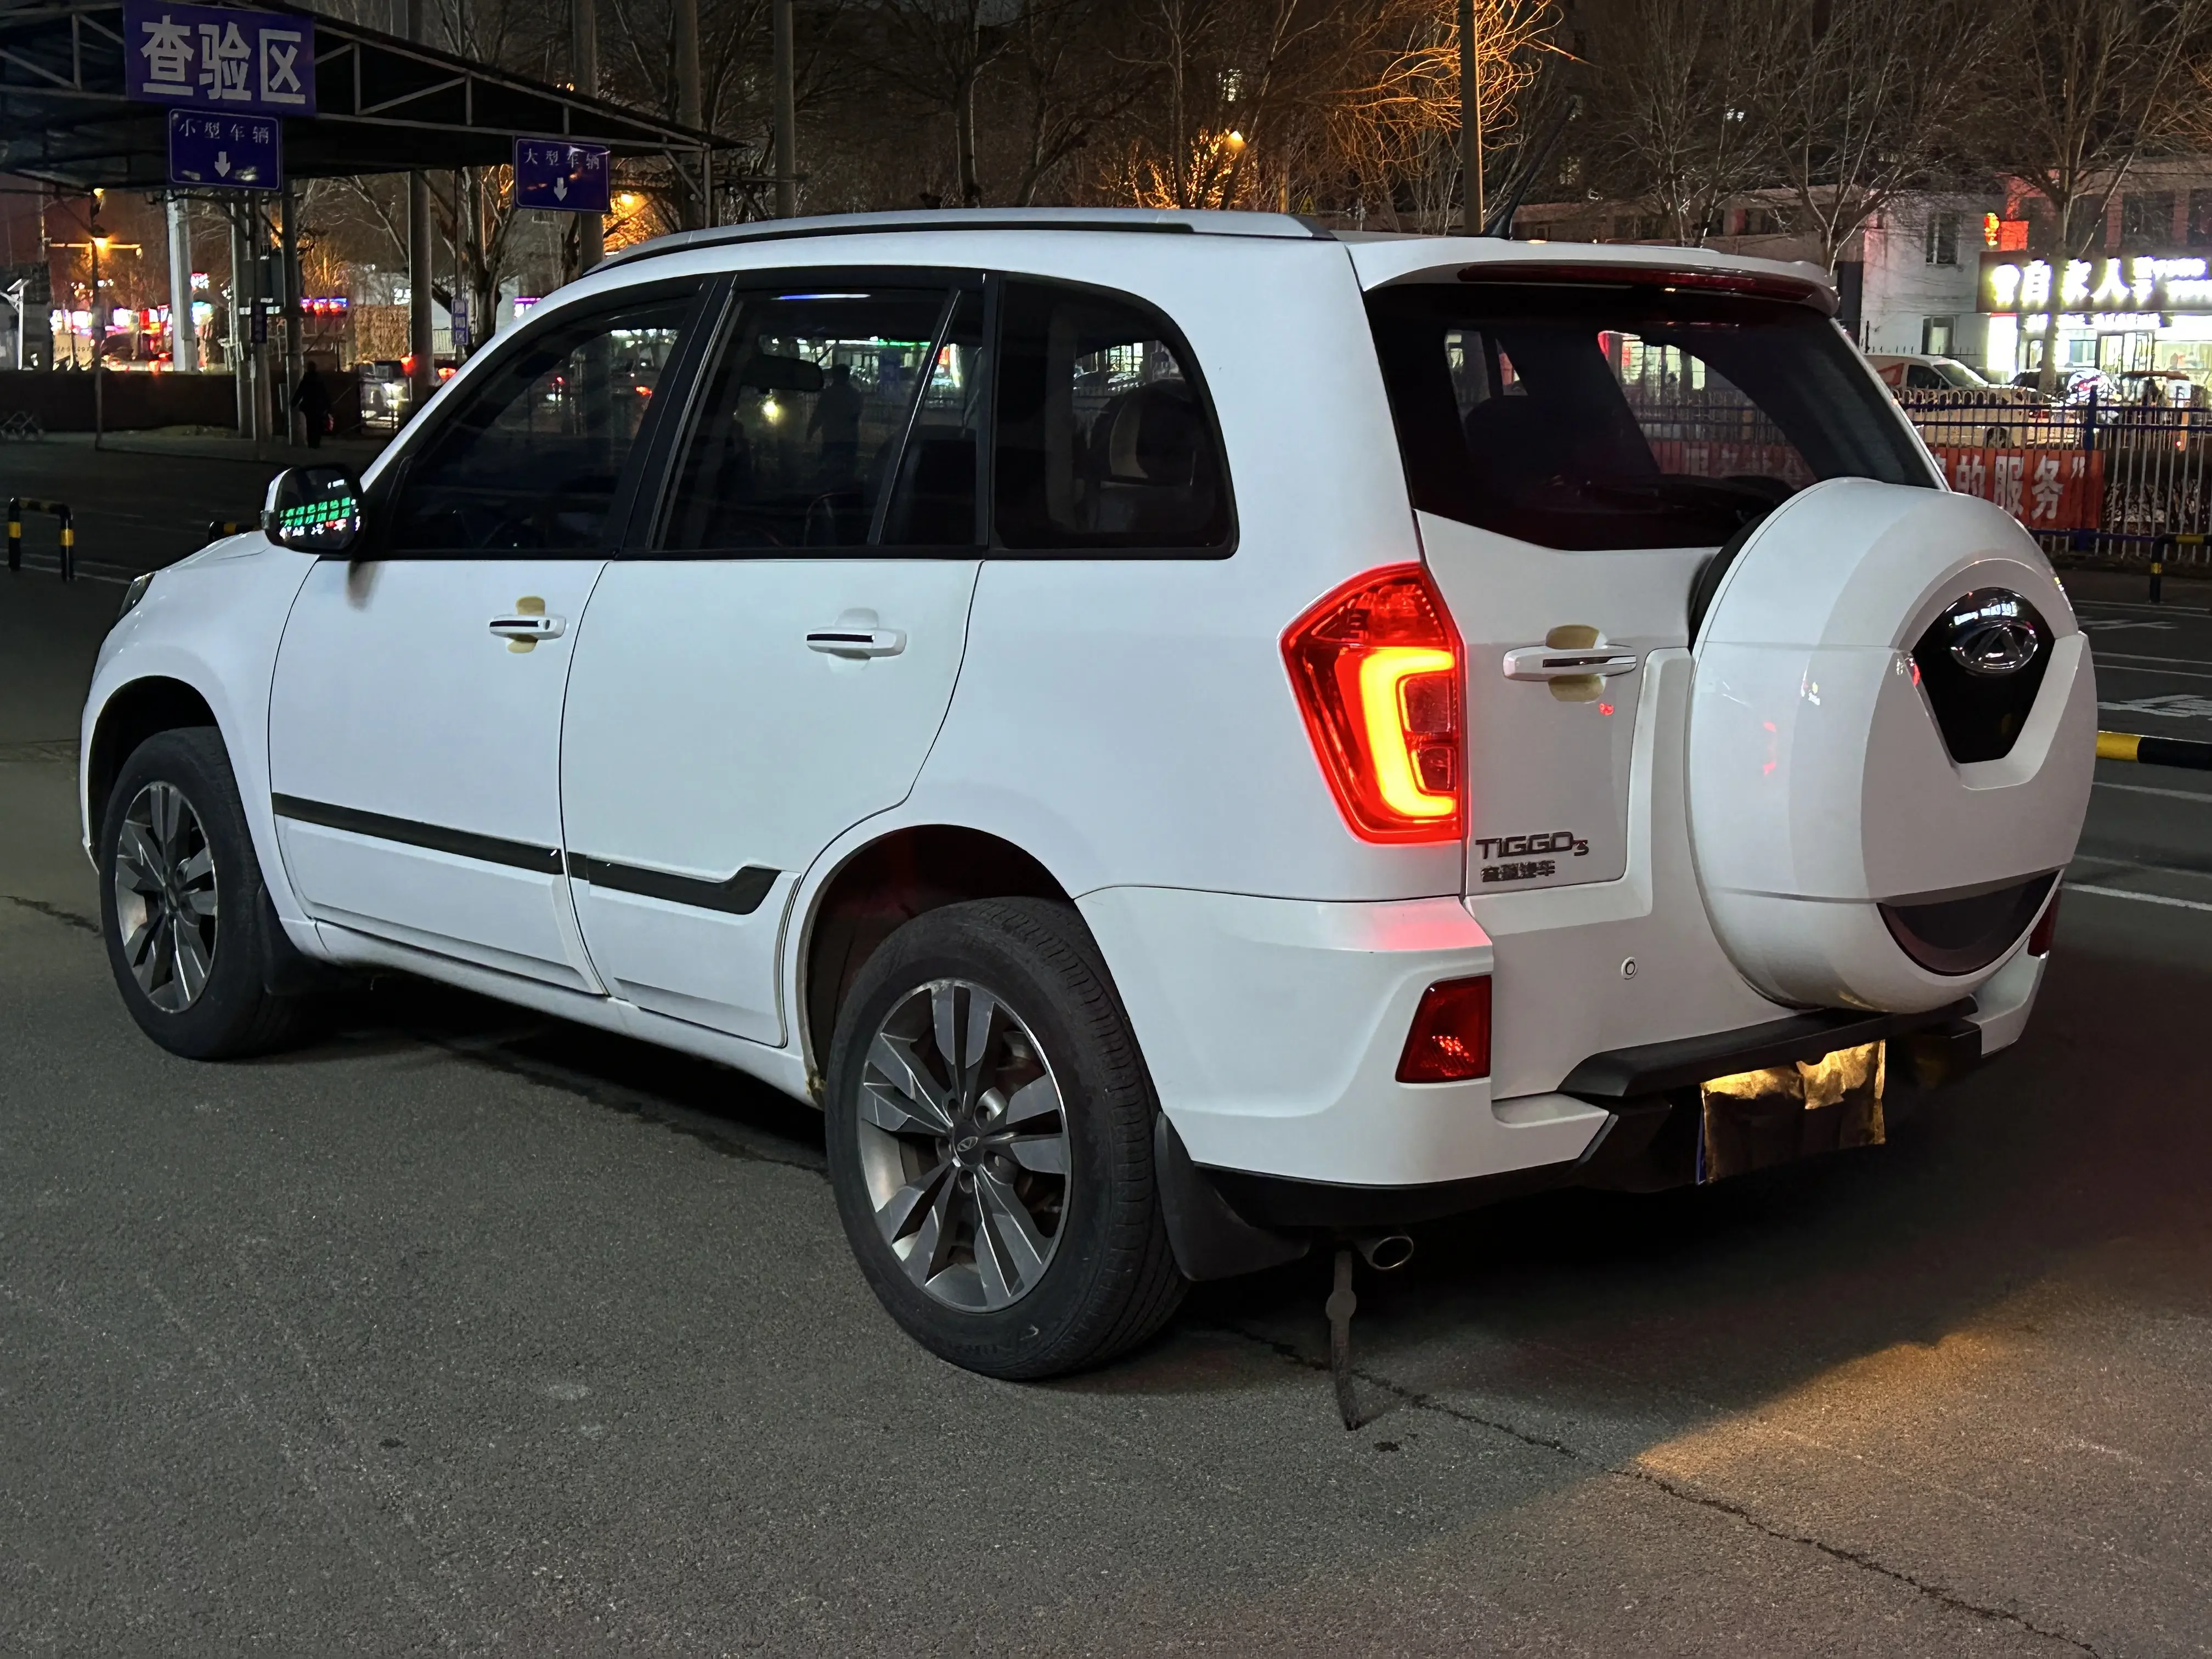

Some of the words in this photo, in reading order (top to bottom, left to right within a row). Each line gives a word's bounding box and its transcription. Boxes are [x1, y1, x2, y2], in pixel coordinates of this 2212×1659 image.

[140, 14, 306, 104] 查验区
[179, 117, 269, 144] 小型车辆
[523, 148, 600, 170] 大型车辆
